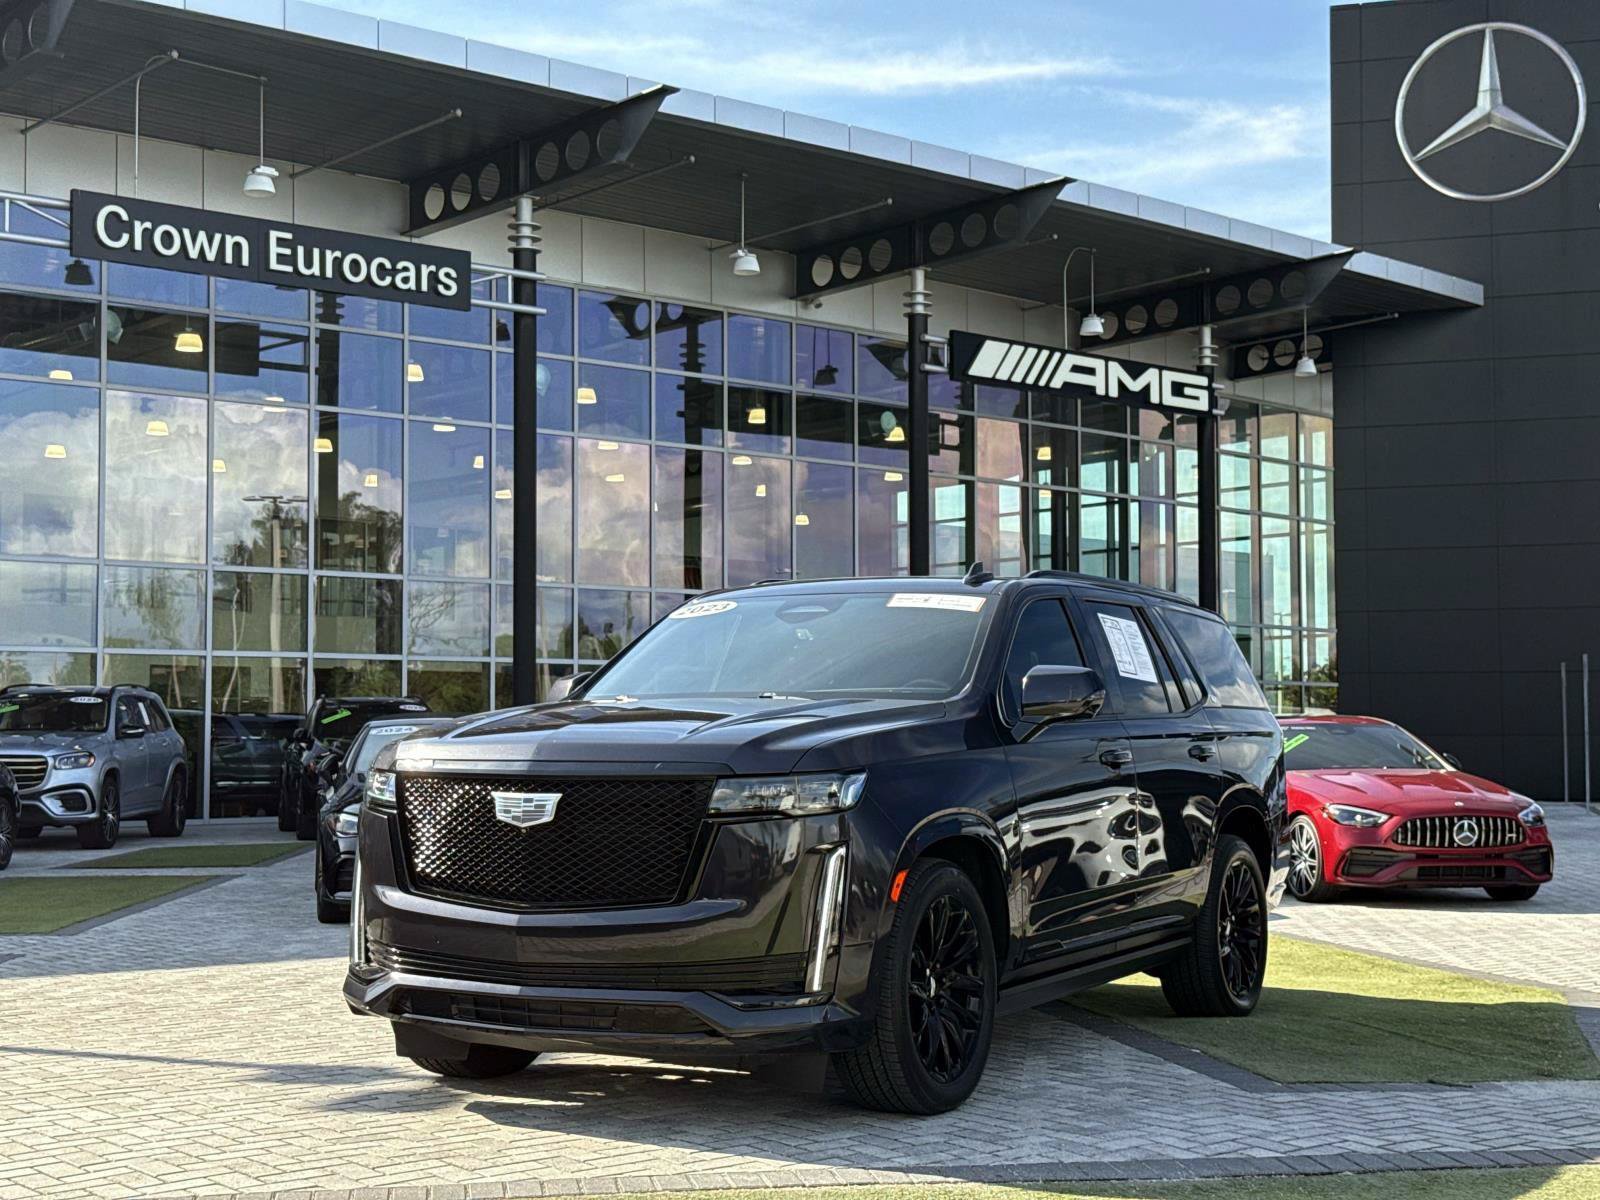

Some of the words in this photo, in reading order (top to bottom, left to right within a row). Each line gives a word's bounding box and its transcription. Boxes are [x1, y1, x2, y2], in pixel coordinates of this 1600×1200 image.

[96, 204, 249, 267] Crown
[269, 230, 458, 297] Eurocars
[1049, 353, 1209, 411] AMG
